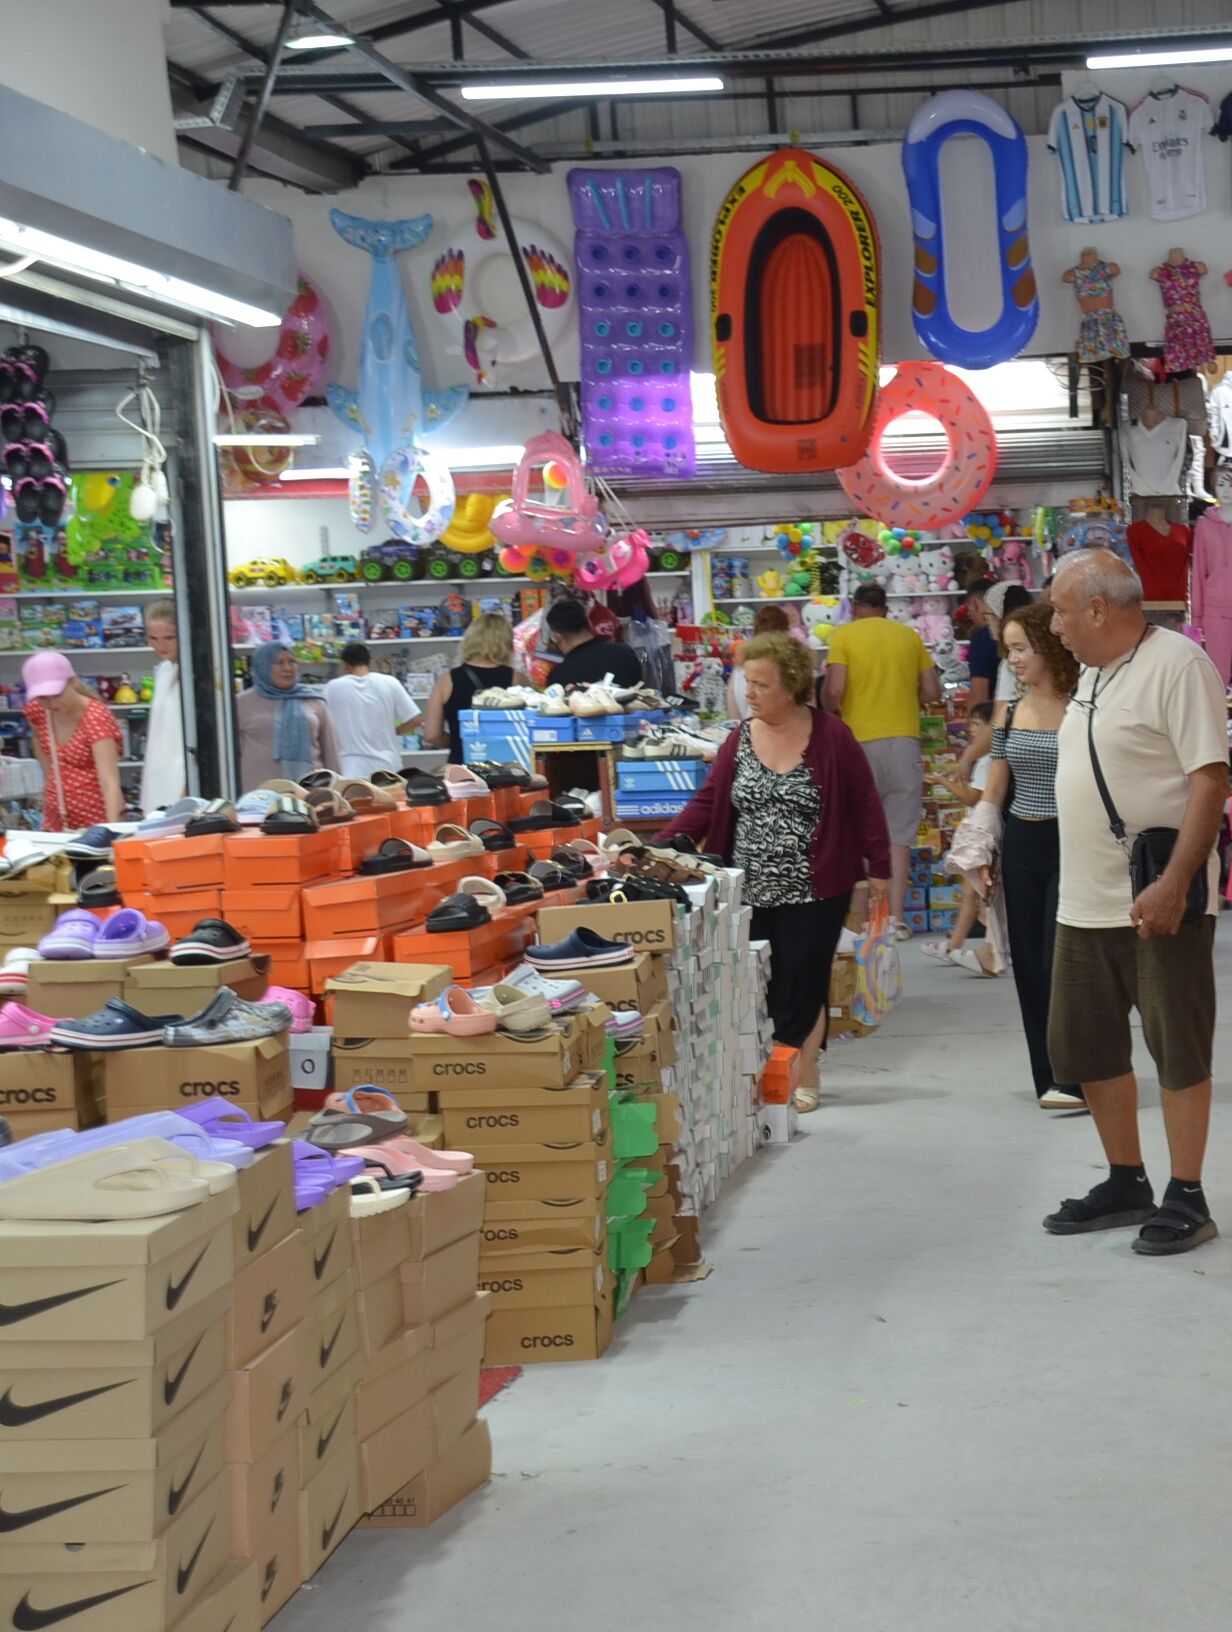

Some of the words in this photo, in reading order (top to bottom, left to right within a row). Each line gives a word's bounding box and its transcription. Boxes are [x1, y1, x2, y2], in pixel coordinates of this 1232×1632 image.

[832, 184, 854, 208] 200
[850, 210, 877, 308] EXPLORER
[640, 803, 685, 815] adidas
[613, 929, 665, 945] crocs
[606, 999, 638, 1012] ocs
[433, 1062, 486, 1076] crocs
[180, 1080, 241, 1097] crocs
[466, 1113, 519, 1129] crocs
[486, 1170, 520, 1184] ocs
[482, 1228, 518, 1242] ocs
[478, 1279, 524, 1293] rocs
[521, 1334, 574, 1349] crocs
